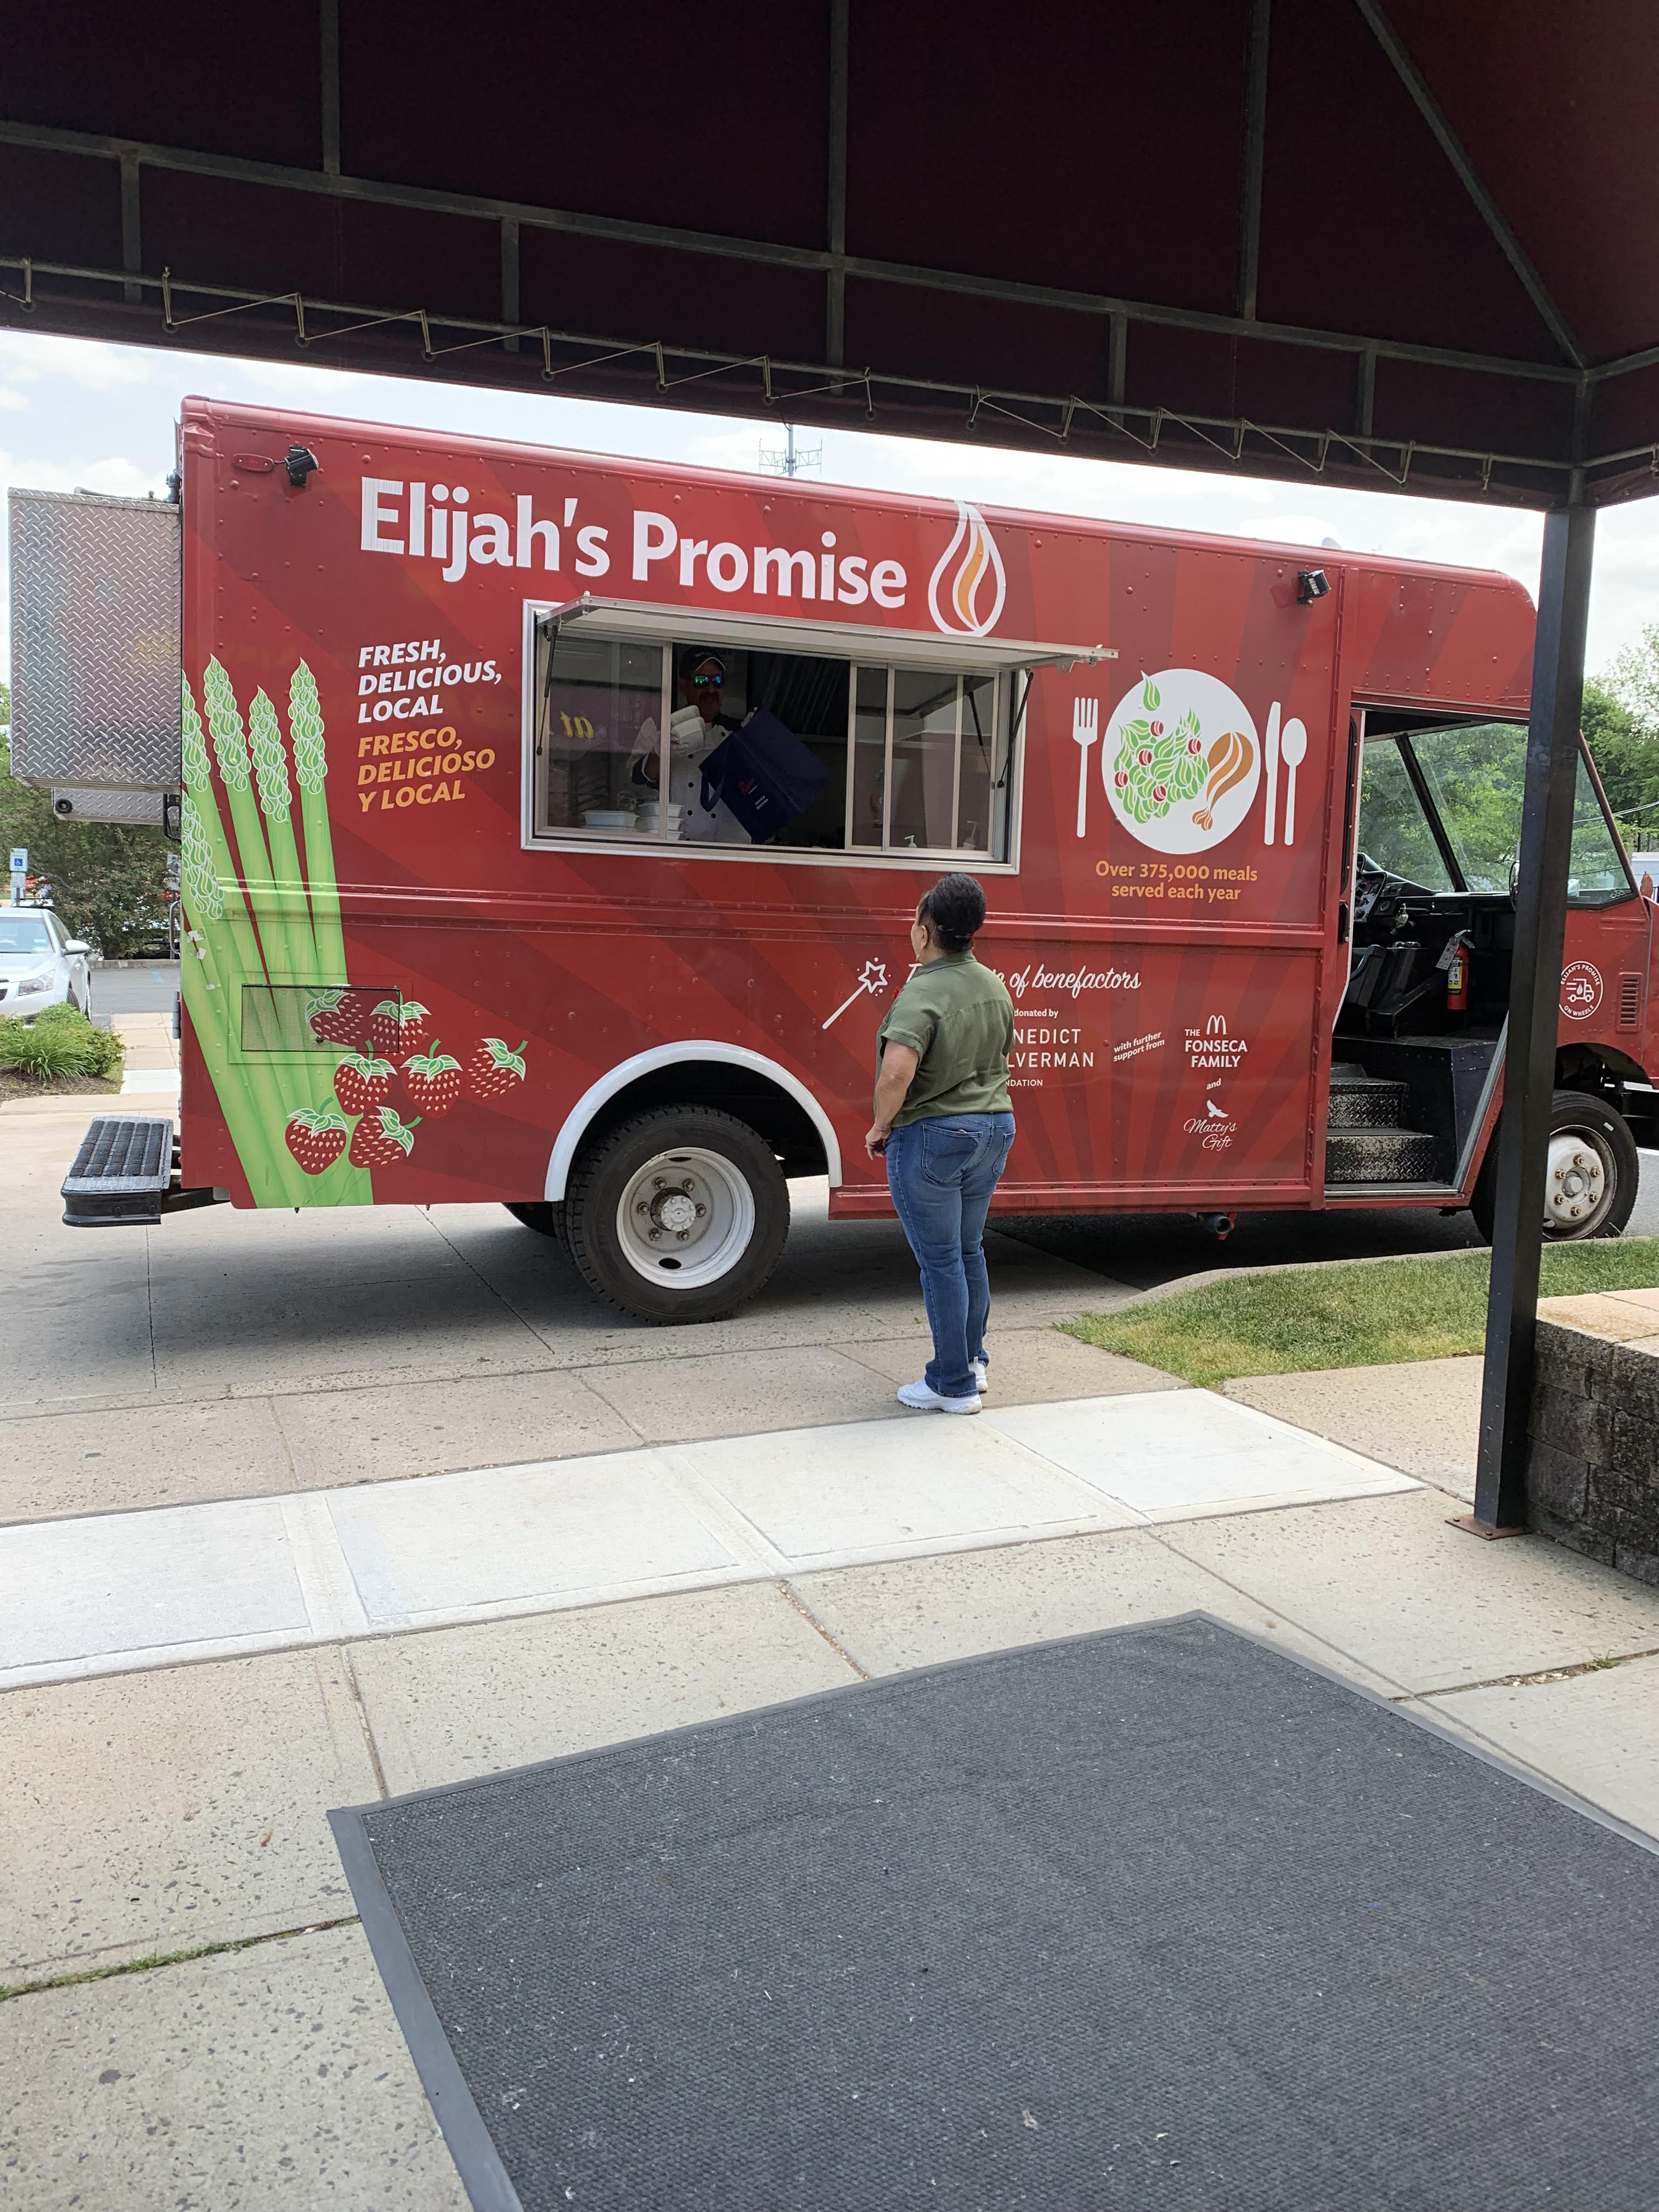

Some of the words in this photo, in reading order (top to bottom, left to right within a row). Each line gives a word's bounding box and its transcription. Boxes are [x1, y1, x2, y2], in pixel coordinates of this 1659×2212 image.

[360, 476, 609, 583] Elijah's
[632, 510, 906, 609] Promise
[358, 639, 446, 668] FRESH,
[358, 660, 501, 696] DELICIOUS,
[358, 694, 443, 724] LOCAL
[358, 726, 462, 758] FRESCO,
[358, 748, 495, 785] DELICIOSO
[358, 791, 377, 812] Y
[381, 780, 465, 810] LOCAL
[1096, 860, 1135, 877] Over
[1139, 864, 1210, 882] 375,000
[1214, 865, 1258, 881] meals
[1111, 882, 1164, 898] served
[1168, 883, 1204, 899] each
[1207, 888, 1242, 903] year
[1009, 964, 1030, 998] of
[1032, 963, 1141, 999] benefactors
[1560, 964, 1581, 985] ELIJAH'S
[1582, 964, 1600, 986] PROMISE
[1014, 1008, 1047, 1017] donated
[1048, 1008, 1059, 1019] by
[1564, 1005, 1572, 1014] ON
[1573, 1005, 1594, 1017] WHEELS
[1013, 1028, 1081, 1045] NEDICT
[1114, 1041, 1131, 1053] with
[1133, 1032, 1161, 1046] further
[1185, 1040, 1248, 1052] FONSECA
[1006, 1052, 1094, 1068] LVERMAN
[1113, 1045, 1144, 1062] support
[1146, 1039, 1165, 1051] from
[1191, 1055, 1241, 1068] FAMILY
[1206, 1077, 1222, 1090] and
[1183, 1118, 1238, 1136] Matty's
[1202, 1133, 1233, 1151] Gift
